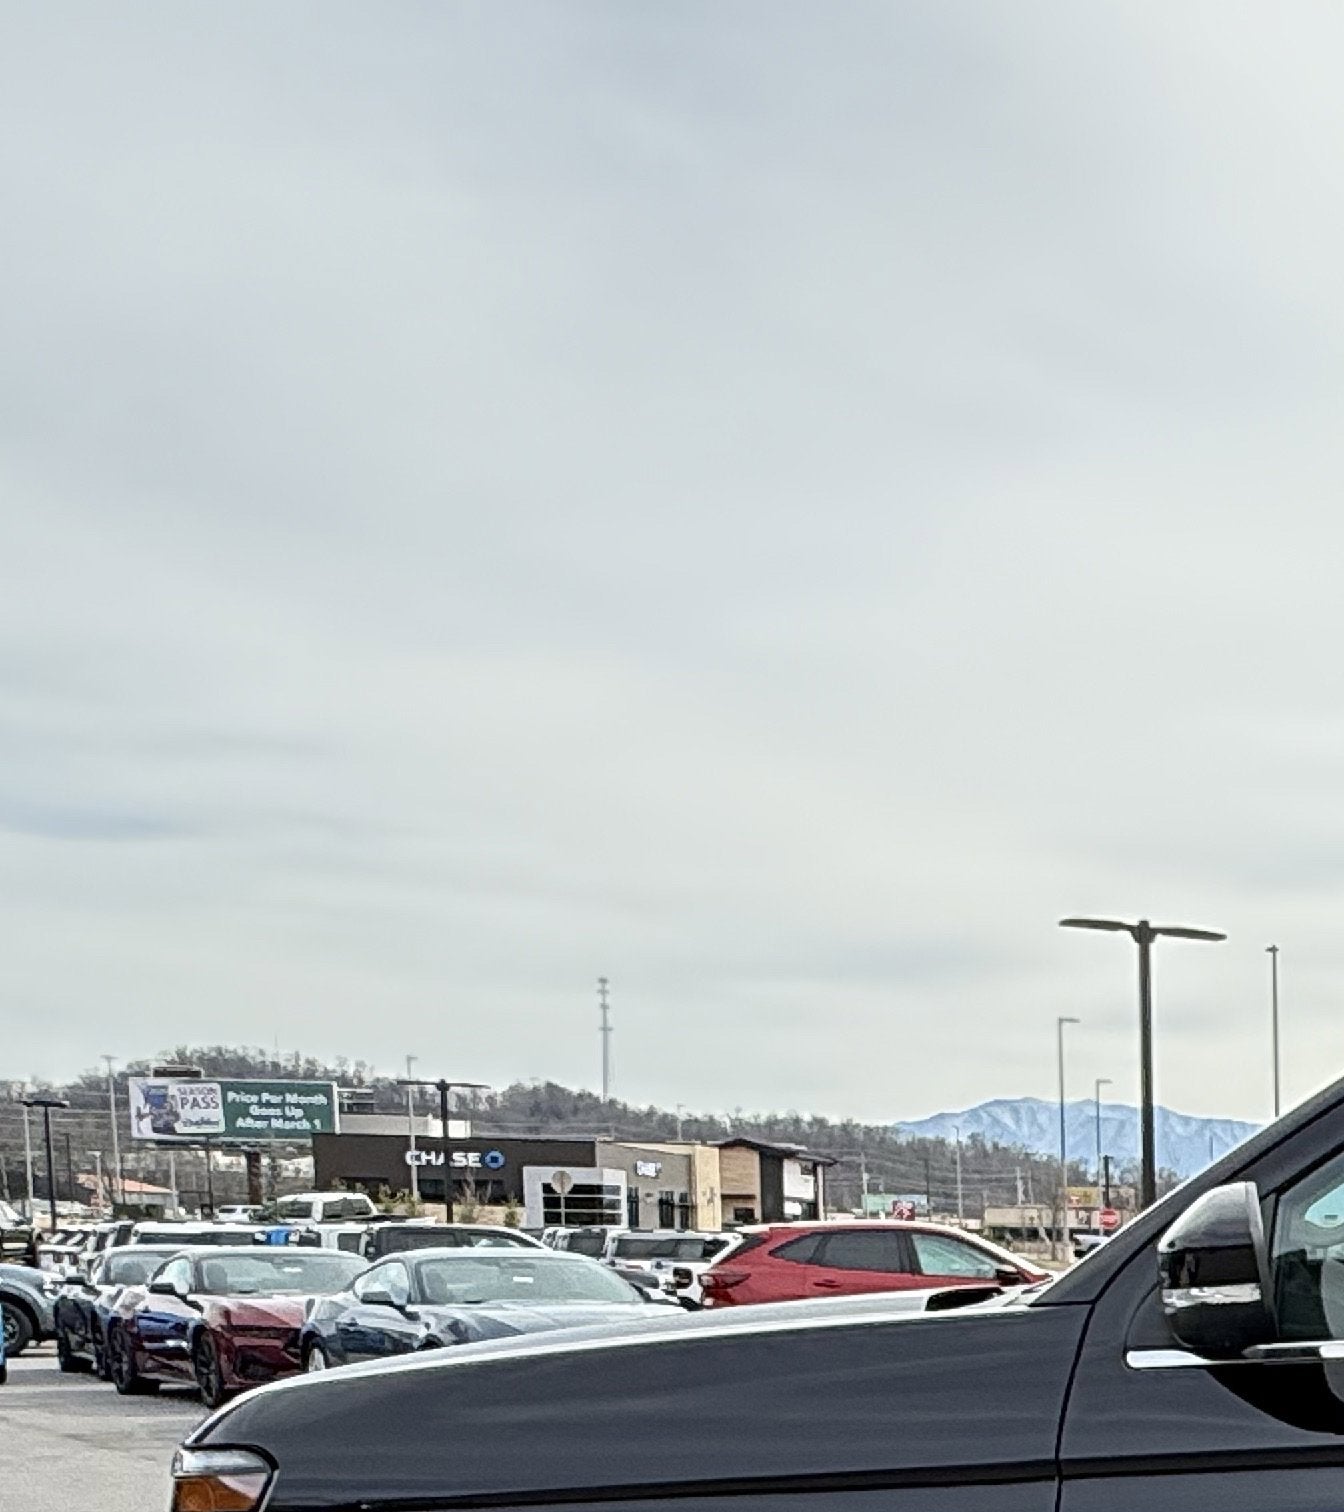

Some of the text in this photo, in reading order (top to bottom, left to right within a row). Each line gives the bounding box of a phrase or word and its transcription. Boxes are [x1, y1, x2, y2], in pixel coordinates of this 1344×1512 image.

[180, 1096, 220, 1110] PASS
[261, 1092, 283, 1104] Per
[284, 1105, 304, 1119] Up
